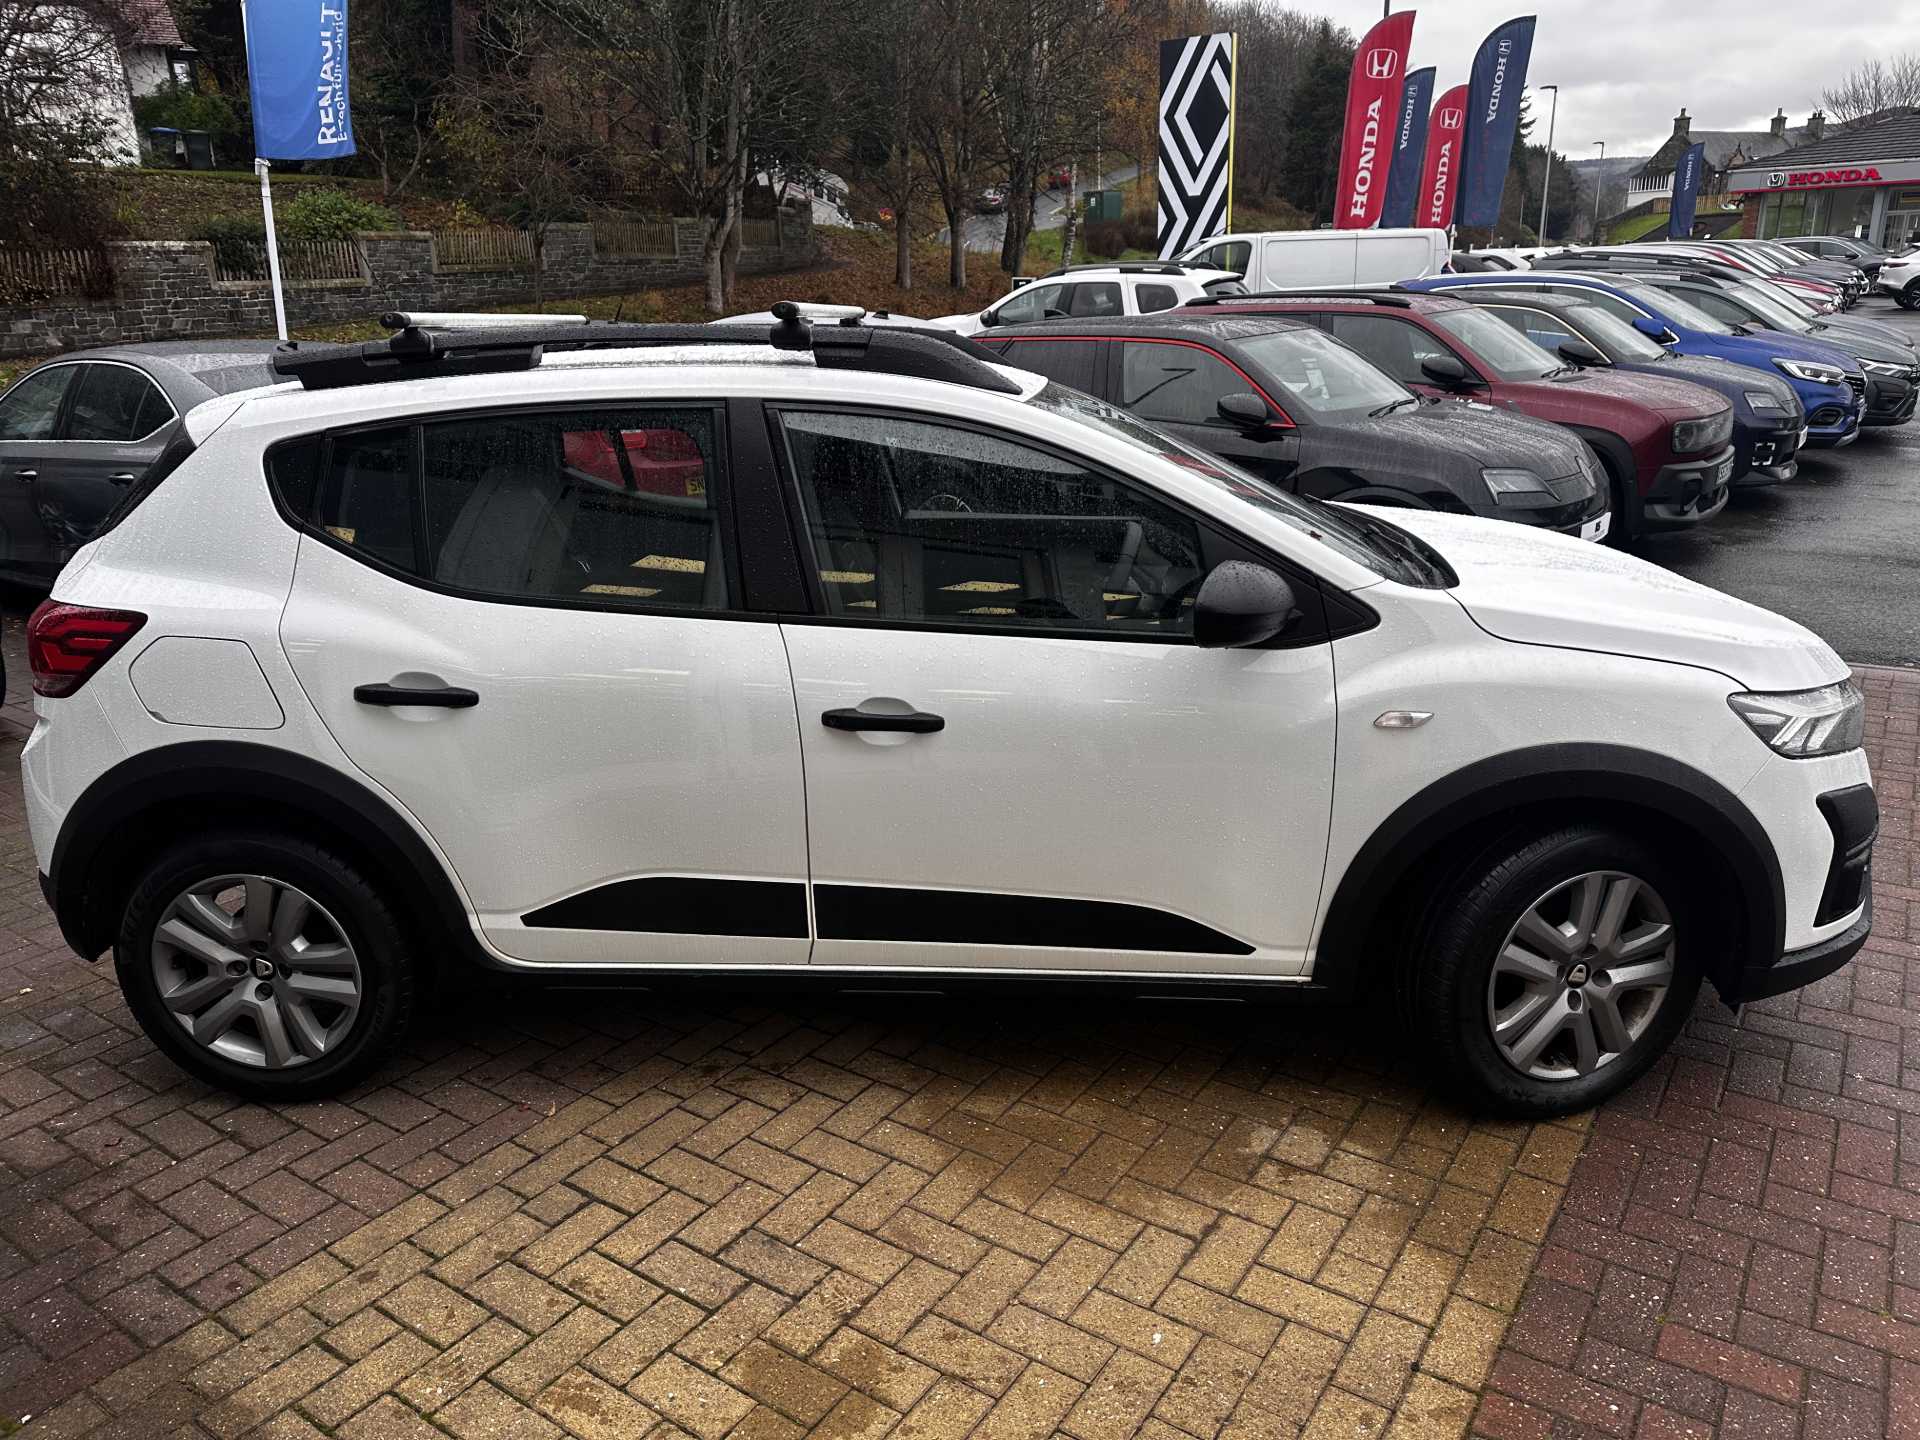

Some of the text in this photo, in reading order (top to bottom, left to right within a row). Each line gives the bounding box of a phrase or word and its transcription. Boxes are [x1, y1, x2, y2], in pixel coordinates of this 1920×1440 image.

[1400, 98, 1415, 150] HONDA
[1486, 56, 1507, 124] HONDA
[1351, 96, 1382, 218] HONDA
[1431, 140, 1453, 223] HONDA
[1787, 167, 1883, 186] HONDA
